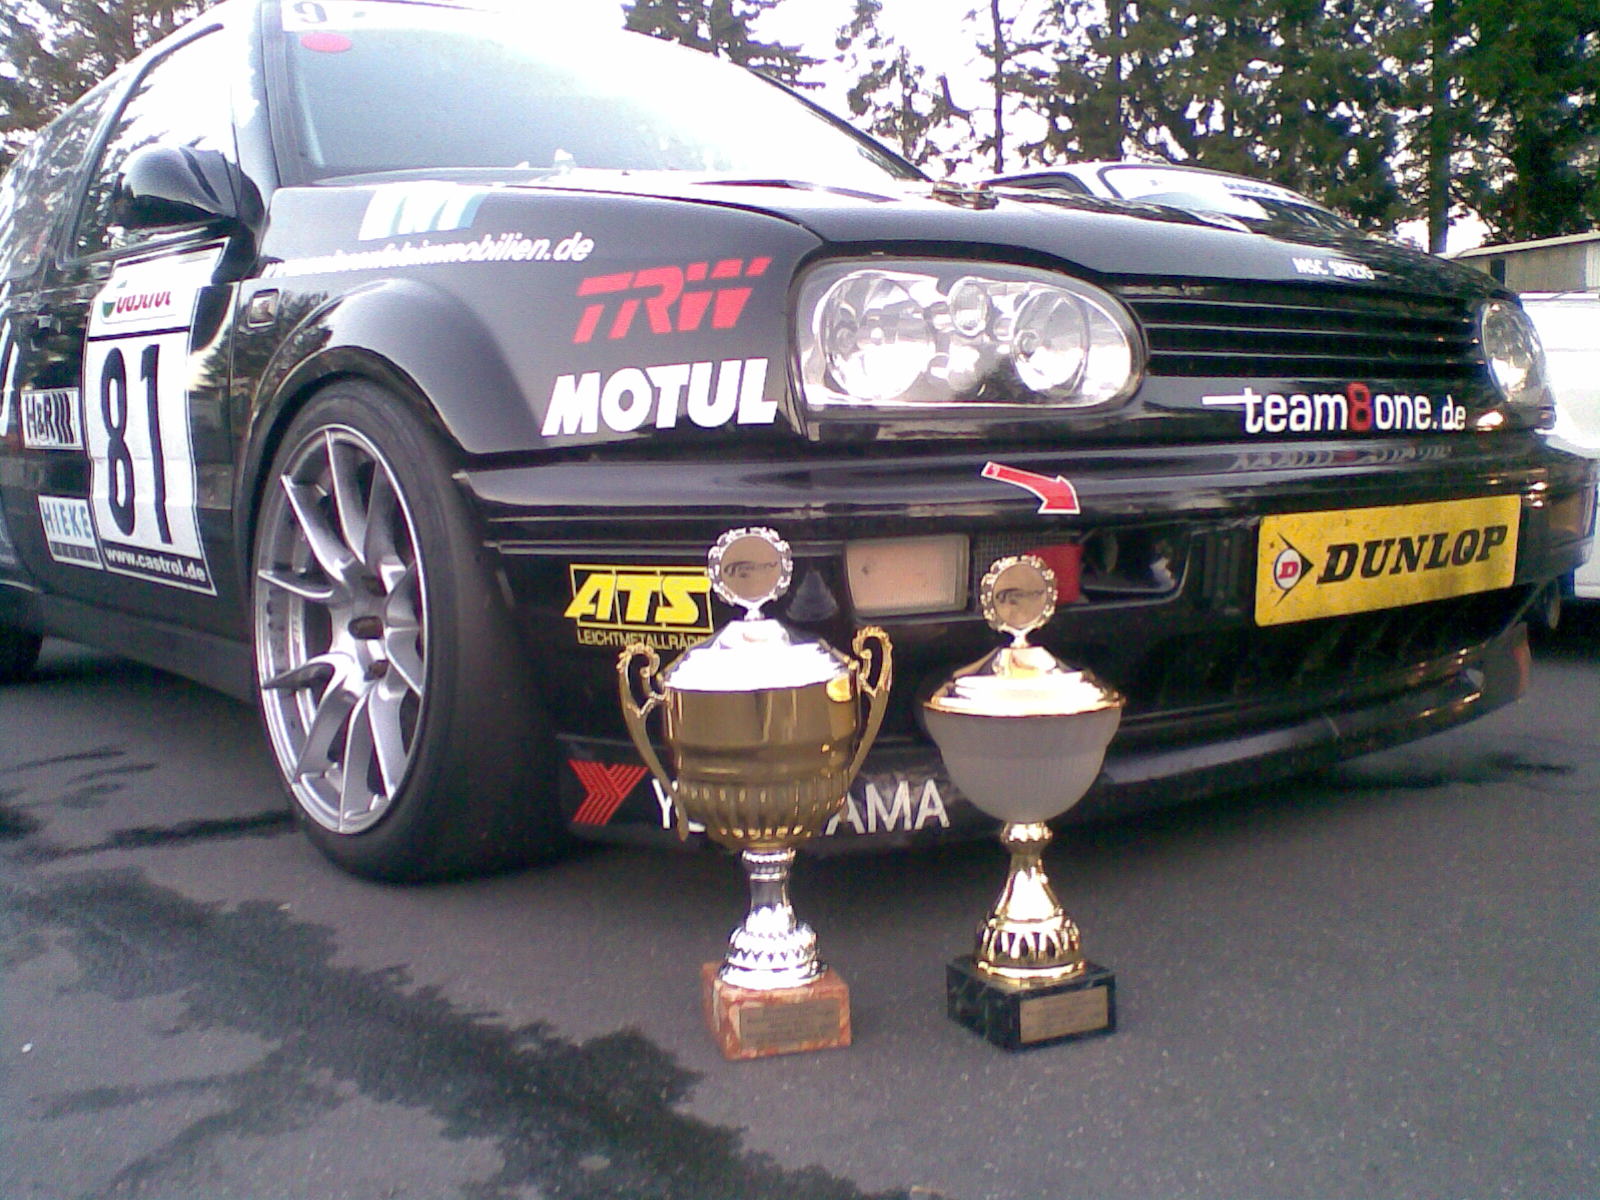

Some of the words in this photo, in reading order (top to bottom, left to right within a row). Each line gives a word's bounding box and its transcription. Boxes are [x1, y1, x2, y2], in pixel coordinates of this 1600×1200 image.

[573, 257, 772, 344] TRW
[541, 358, 778, 437] MOTUL
[1202, 382, 1467, 435] team8one.de
[100, 344, 173, 546] 81
[41, 502, 92, 539] HIEKE
[104, 547, 207, 582] www.castrol.de
[1278, 561, 1300, 579] D
[1316, 525, 1508, 585] DUNLOP
[564, 573, 712, 624] ATS
[652, 778, 951, 836] YAMA
